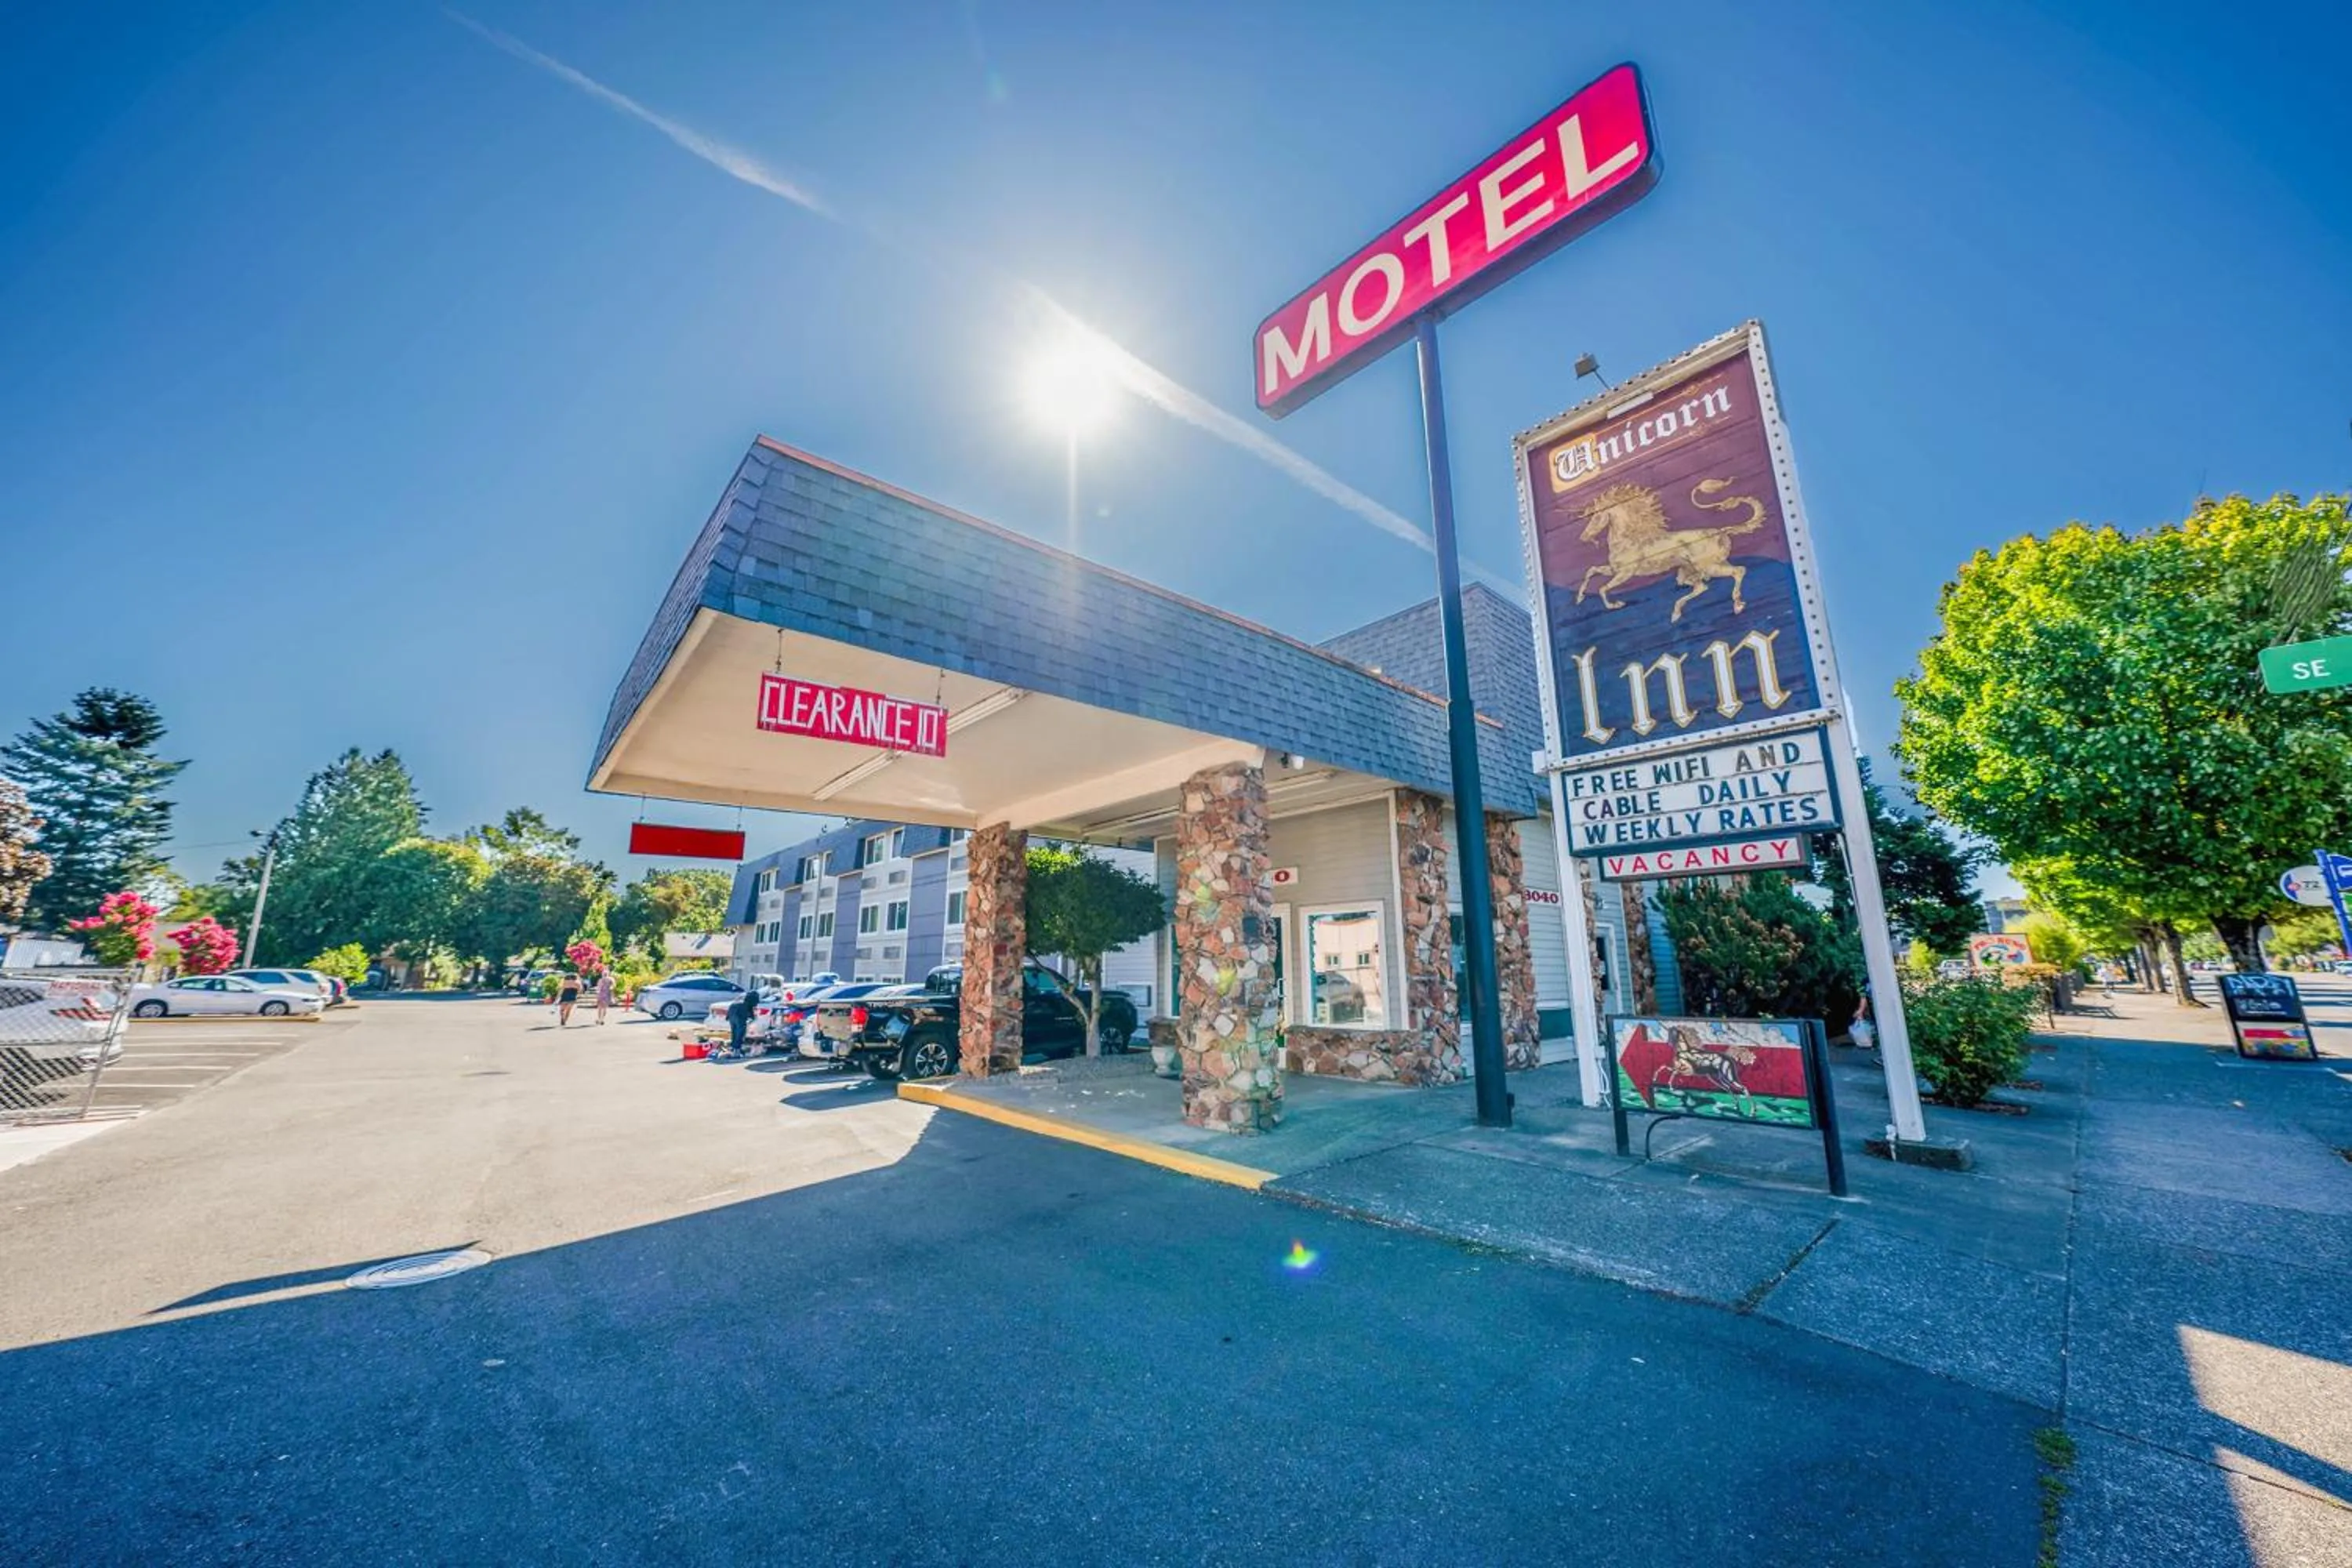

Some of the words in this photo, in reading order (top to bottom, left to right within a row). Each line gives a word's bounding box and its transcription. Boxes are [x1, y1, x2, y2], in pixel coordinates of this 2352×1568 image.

[1262, 114, 1639, 394] MOTEL
[1555, 385, 1732, 481] Unicorn
[1571, 630, 1791, 744] Inn
[2292, 659, 2332, 680] SE
[761, 679, 913, 746] CLEARANCE
[1573, 769, 1638, 797] FREE
[1653, 756, 1711, 785] WIFI
[1736, 742, 1800, 772] AND
[1583, 791, 1662, 820] CABLE
[1698, 771, 1791, 806] DAILY
[1584, 812, 1703, 844] WEEKLY
[1719, 797, 1820, 830] RATES
[1609, 840, 1791, 875] VACANCY
